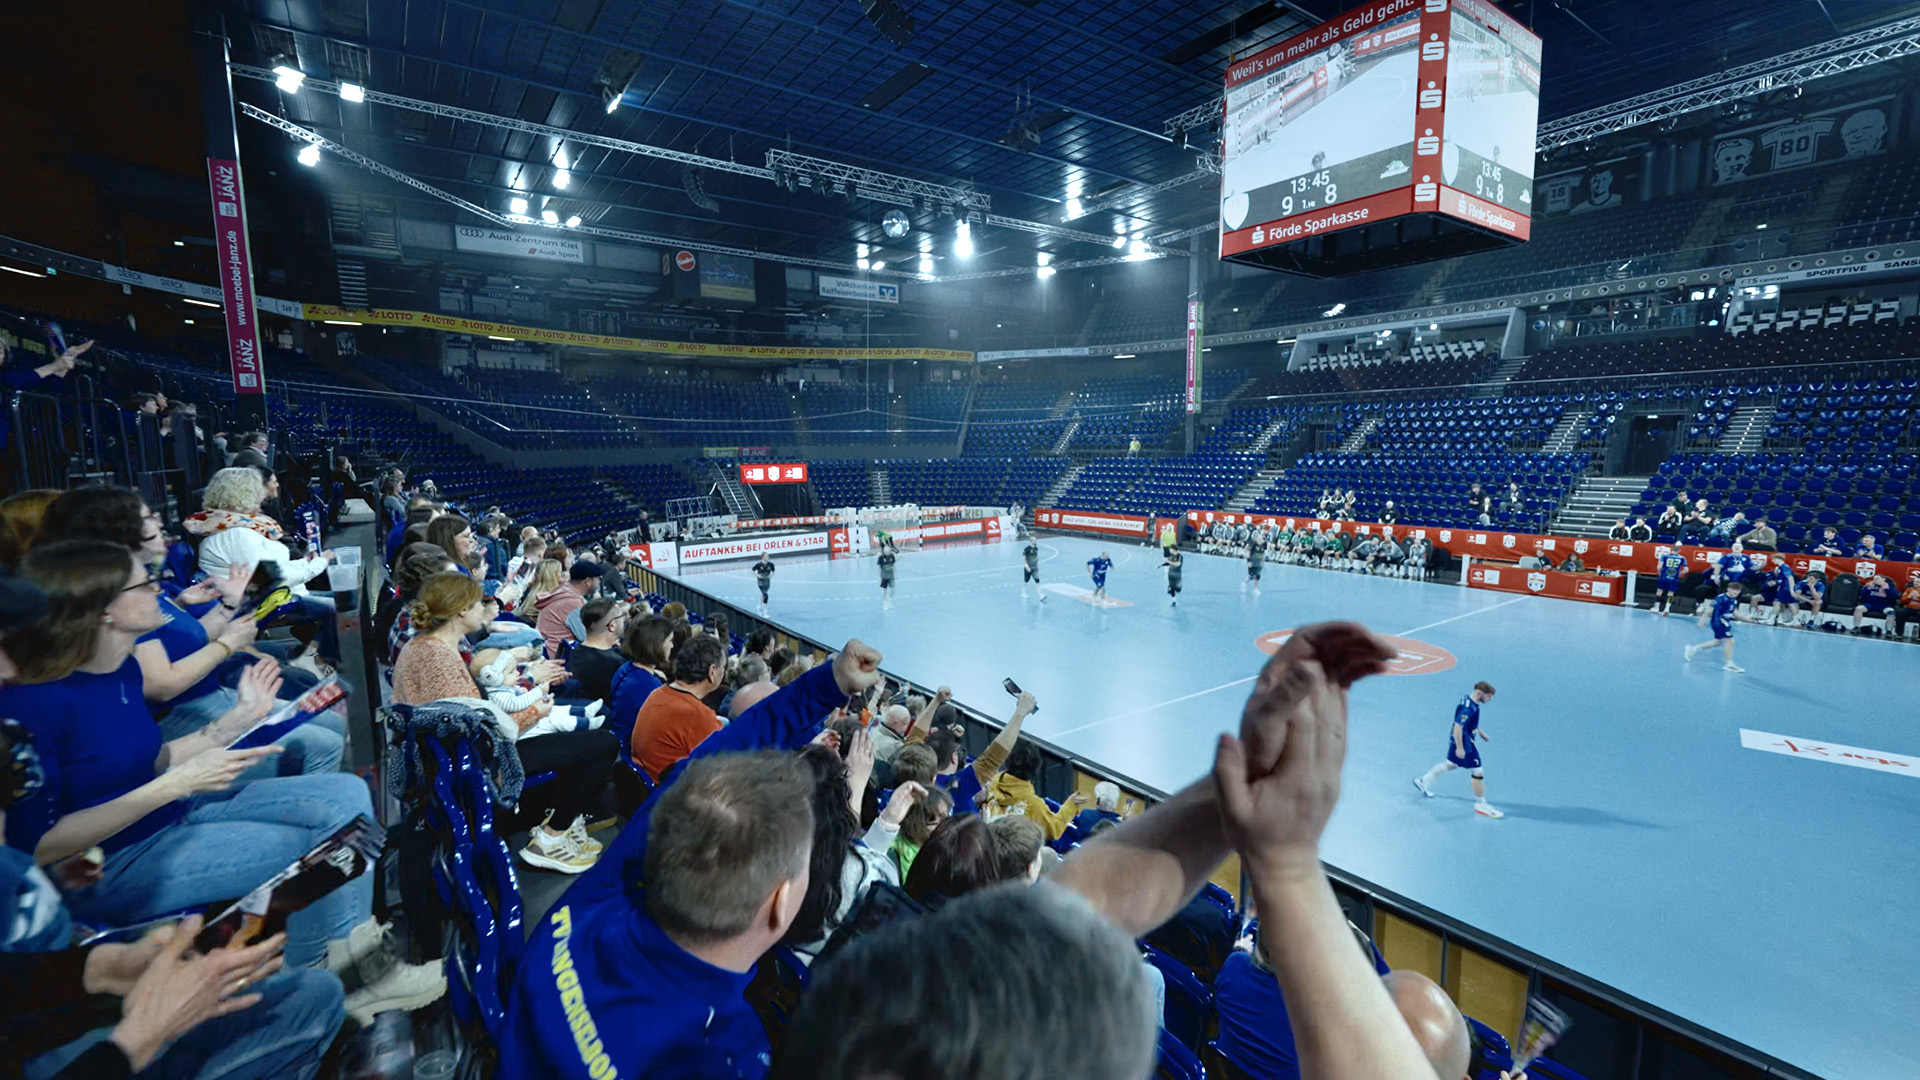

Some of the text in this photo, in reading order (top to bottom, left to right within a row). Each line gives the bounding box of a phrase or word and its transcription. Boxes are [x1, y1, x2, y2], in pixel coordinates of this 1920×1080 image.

[1232, 0, 1414, 81] Weil's um mehr als Geld geht.
[1780, 136, 1809, 156] 80
[1482, 161, 1501, 182] 13:45
[220, 165, 236, 201] JANZ
[1290, 170, 1330, 194] 13:45
[1476, 175, 1483, 195] 9
[1497, 184, 1504, 204] 8
[1551, 187, 1565, 199] 18
[1281, 196, 1293, 216] 9
[1325, 184, 1337, 204] 8
[1269, 223, 1301, 240] Förde
[1304, 208, 1369, 233] Sparkasse
[1468, 203, 1485, 221] Förde
[1486, 209, 1516, 231] Sparkasse
[488, 232, 579, 250] Audi Zentrum Kiel
[117, 268, 142, 281] DIERCK
[226, 230, 247, 326] www.moebel-janz.de
[1806, 264, 1868, 278] SPORTFIVE
[161, 278, 185, 289] DIERCK
[836, 280, 876, 291] Volksbanken
[821, 287, 876, 299] Raiffeisenbanken
[381, 311, 414, 321] LOTTO
[432, 317, 456, 326] LOTTO
[470, 322, 493, 331] LOTTO
[507, 327, 530, 336] LOTTO
[543, 331, 565, 340] LOTTO
[578, 335, 599, 343] LOTTO
[611, 338, 633, 346] LOTTO
[240, 338, 255, 371] JANZ
[684, 545, 743, 559] AUFTANKEN
[746, 543, 761, 552] BEI
[763, 539, 793, 551] ORLEN
[795, 537, 801, 547] &
[803, 535, 825, 546] STAR
[1666, 558, 1681, 568] 82
